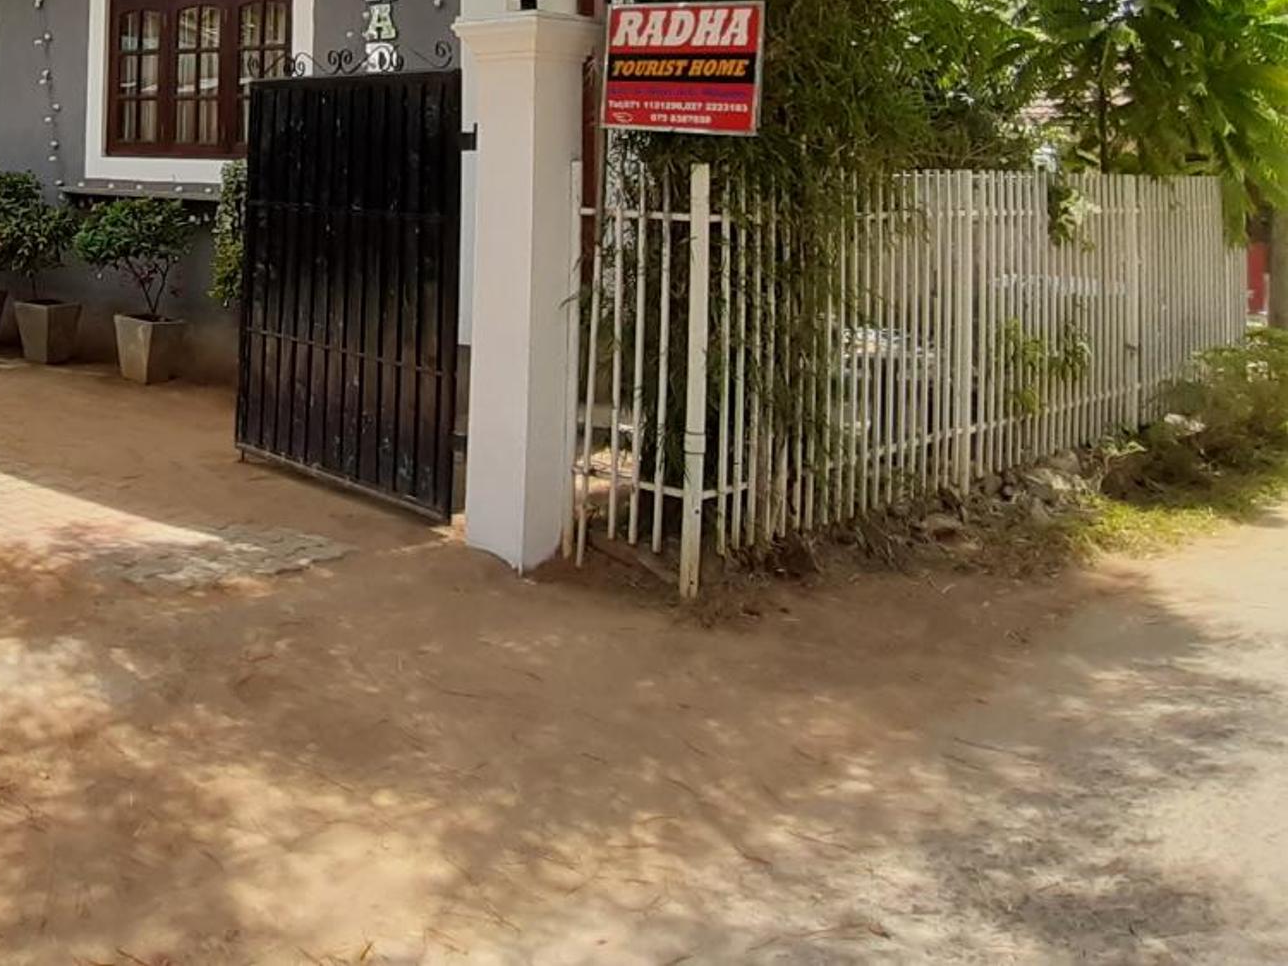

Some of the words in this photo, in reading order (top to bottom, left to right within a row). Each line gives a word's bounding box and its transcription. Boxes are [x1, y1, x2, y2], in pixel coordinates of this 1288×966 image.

[612, 8, 752, 47] RADHA
[612, 59, 688, 77] TOURIST
[688, 59, 749, 77] HOME
